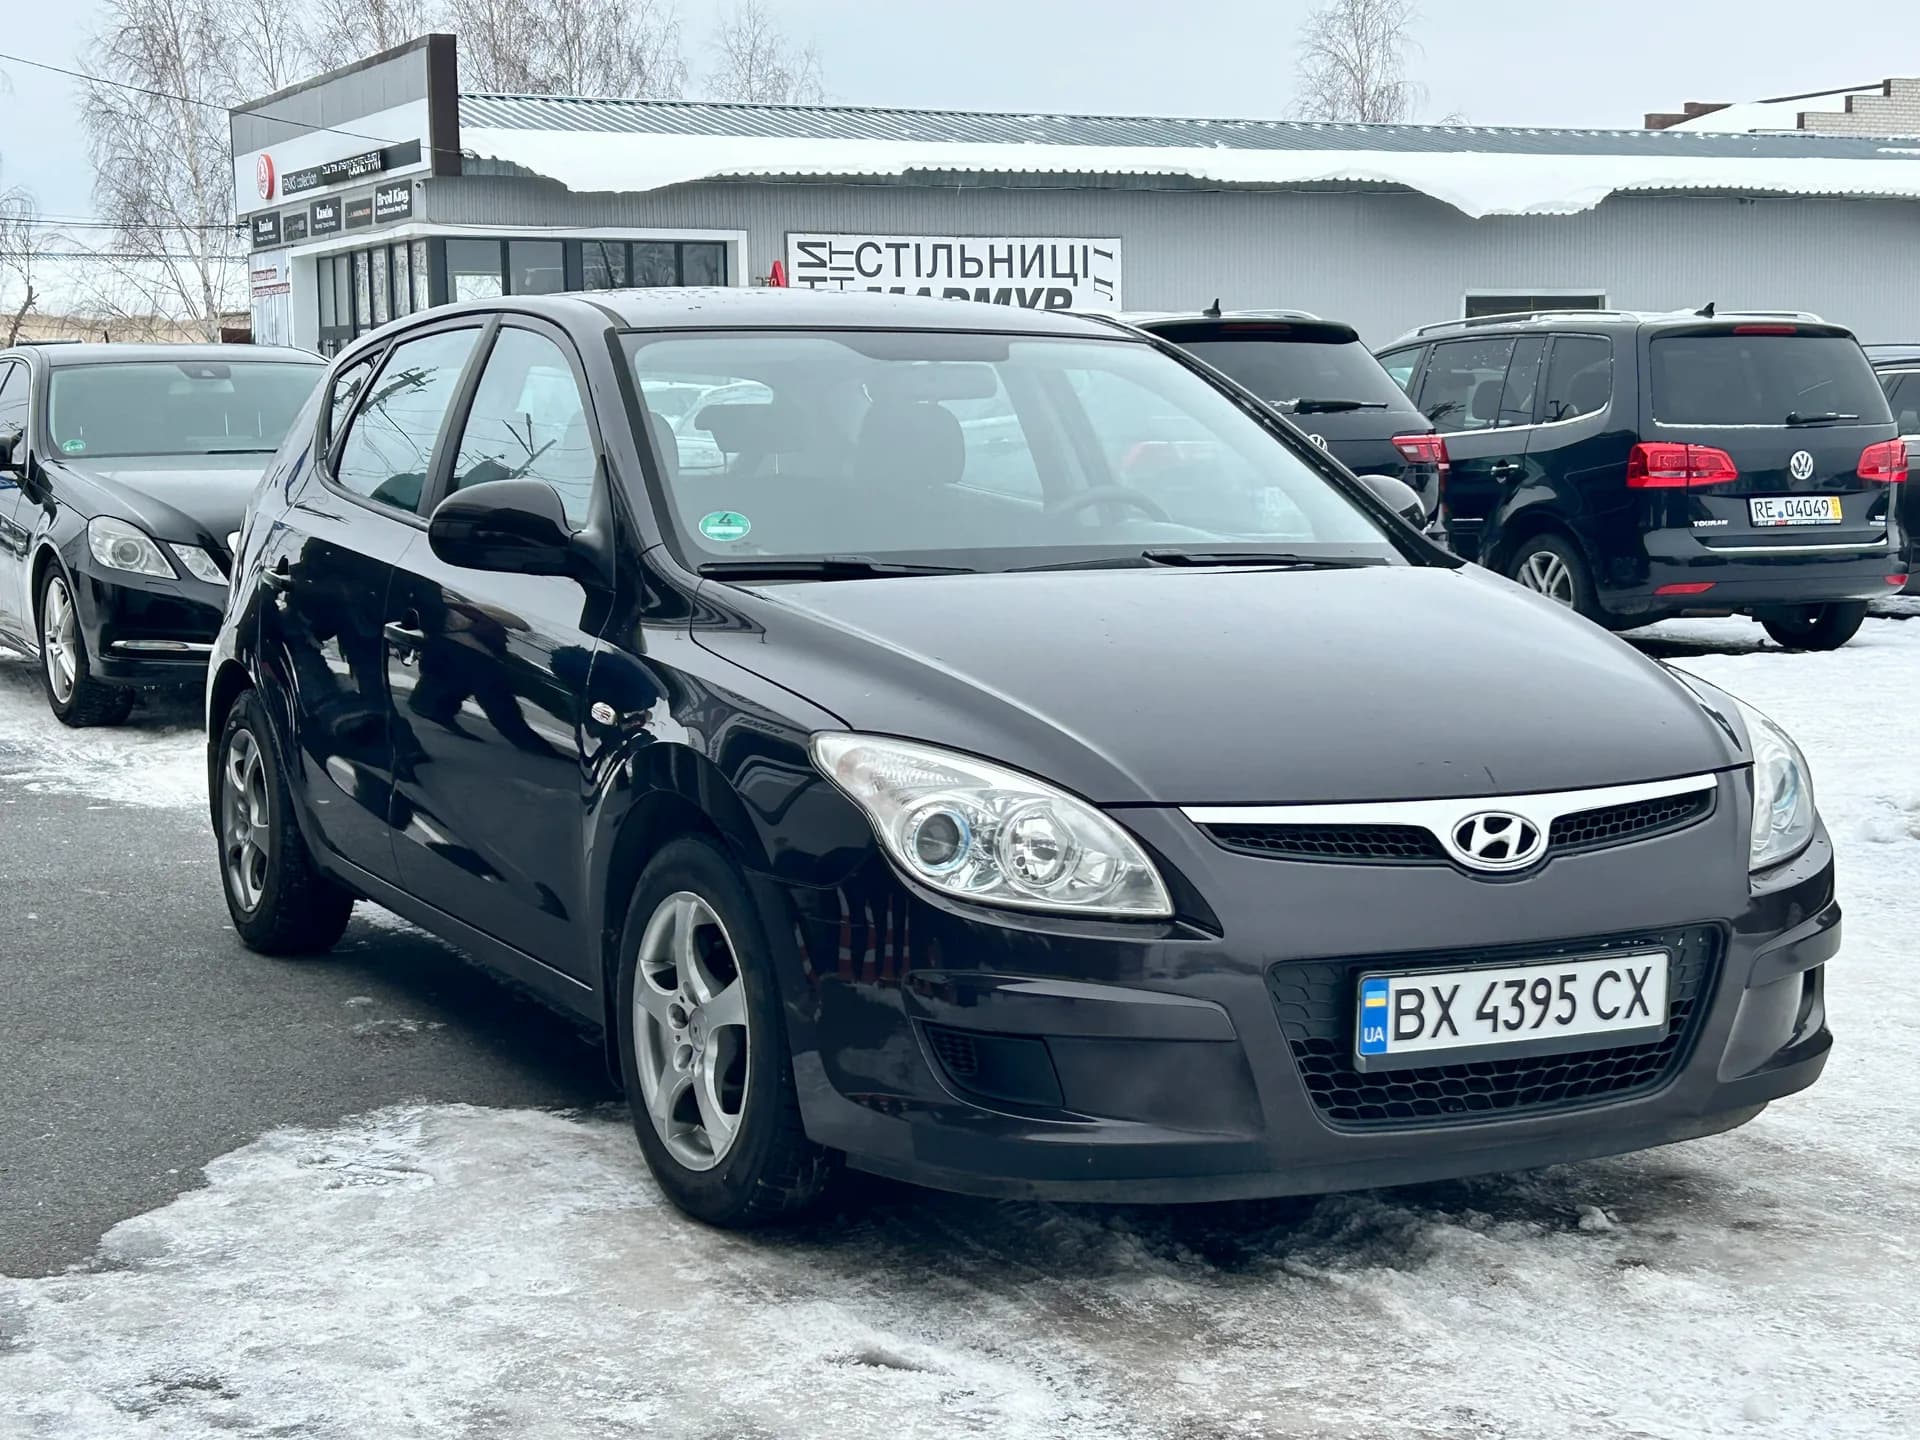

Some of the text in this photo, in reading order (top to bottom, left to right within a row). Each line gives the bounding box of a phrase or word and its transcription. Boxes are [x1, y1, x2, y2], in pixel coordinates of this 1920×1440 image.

[854, 241, 1089, 287] СТІЛЬНИЦІ
[1754, 500, 1776, 519] RE
[1785, 499, 1830, 518] 04049
[1393, 966, 1652, 1041] BX 4395 CX
[1364, 1027, 1385, 1043] UA
